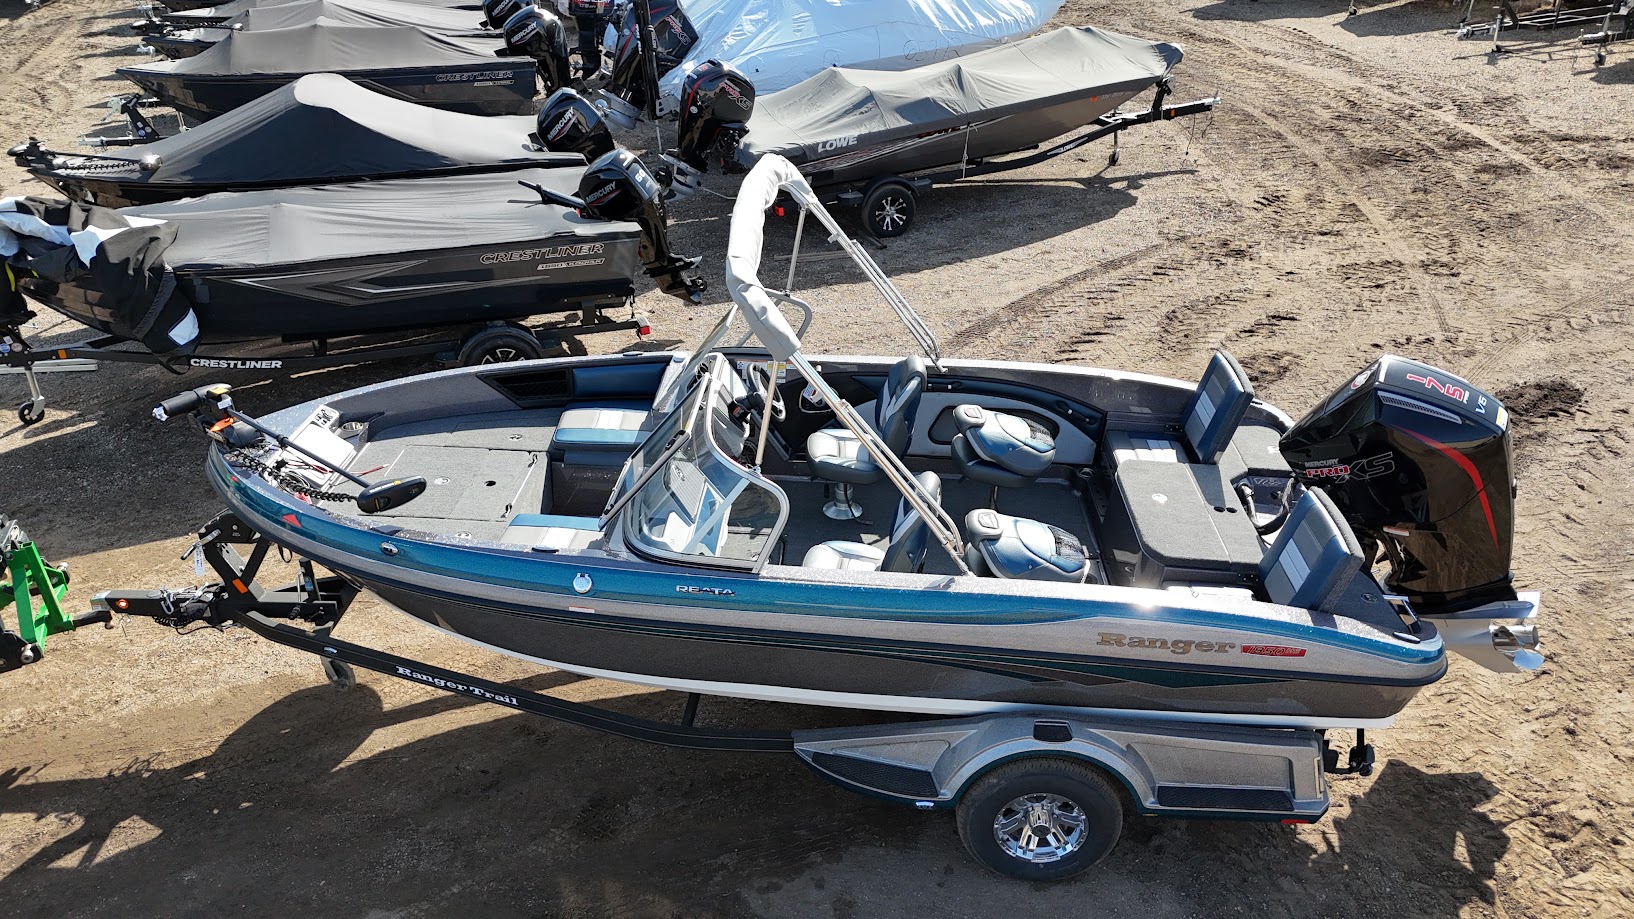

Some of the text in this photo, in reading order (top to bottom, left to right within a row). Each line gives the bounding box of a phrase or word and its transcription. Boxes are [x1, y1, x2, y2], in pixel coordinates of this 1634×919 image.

[511, 21, 537, 43] MERCURY
[435, 70, 514, 82] CRESTLINER
[547, 106, 574, 141] MERCURY
[818, 136, 858, 153] LOWE
[585, 181, 616, 203] MERCURY
[480, 243, 605, 265] CRESTLINER
[190, 358, 283, 369] CRESTLINER
[1475, 395, 1488, 414] V6
[1304, 458, 1339, 468] MERCURY
[675, 585, 735, 597] REATA
[1097, 632, 1237, 655] Ranger
[395, 665, 468, 692] Ranger
